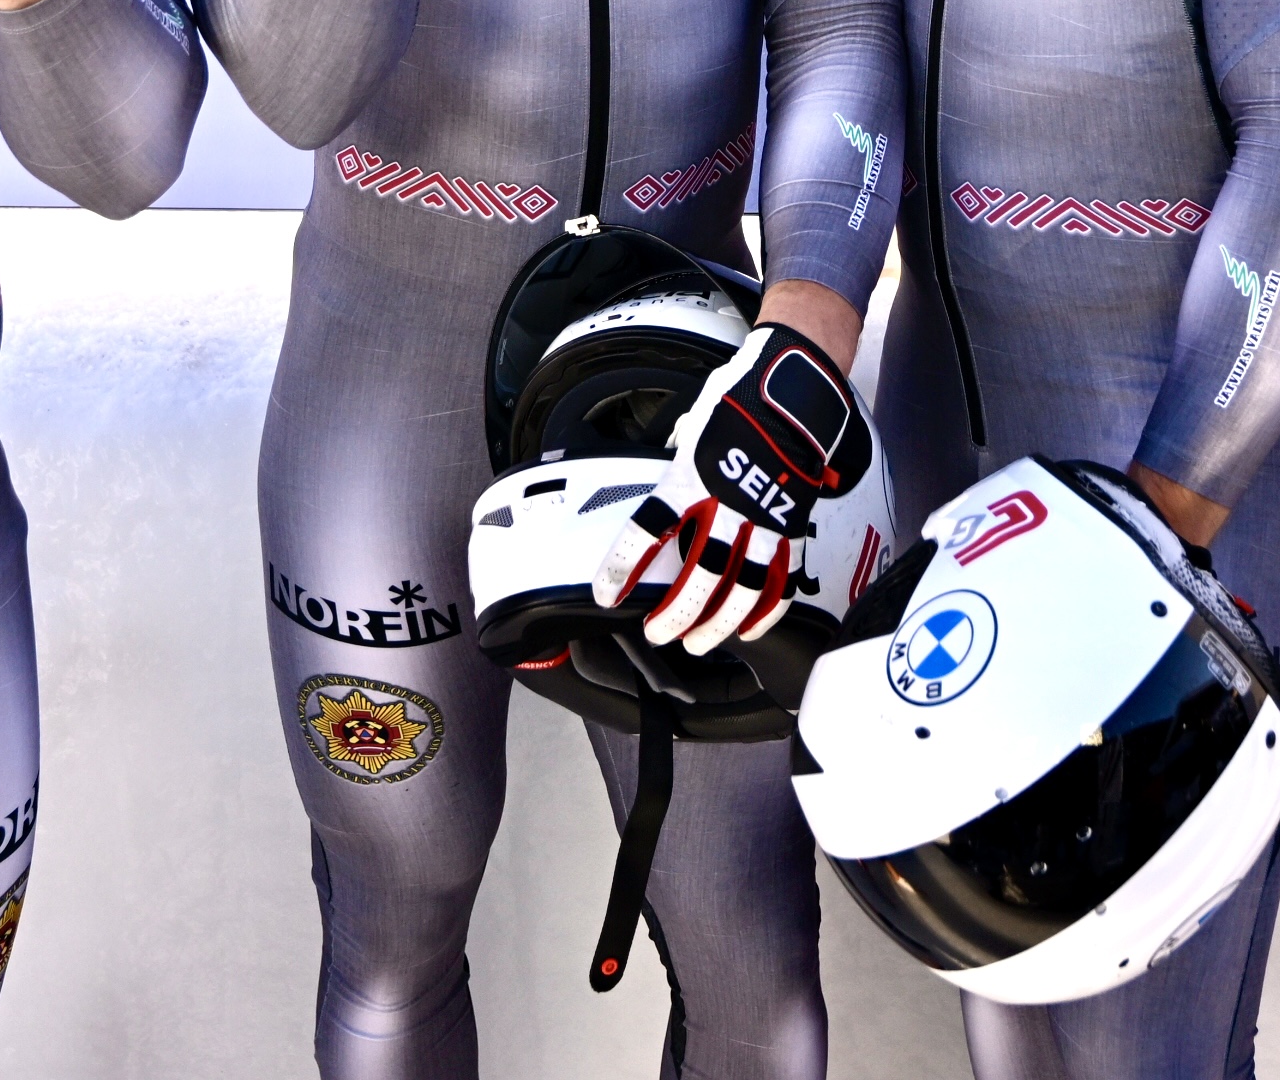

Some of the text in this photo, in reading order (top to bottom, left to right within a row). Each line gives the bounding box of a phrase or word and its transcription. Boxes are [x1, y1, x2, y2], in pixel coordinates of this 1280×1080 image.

[1215, 348, 1254, 408] LATVIJAS
[1243, 304, 1272, 350] VALSTS
[719, 448, 796, 527] SEIZ
[269, 561, 463, 648] NORFIN
[518, 660, 555, 671] GENCY
[892, 642, 943, 700] BMW
